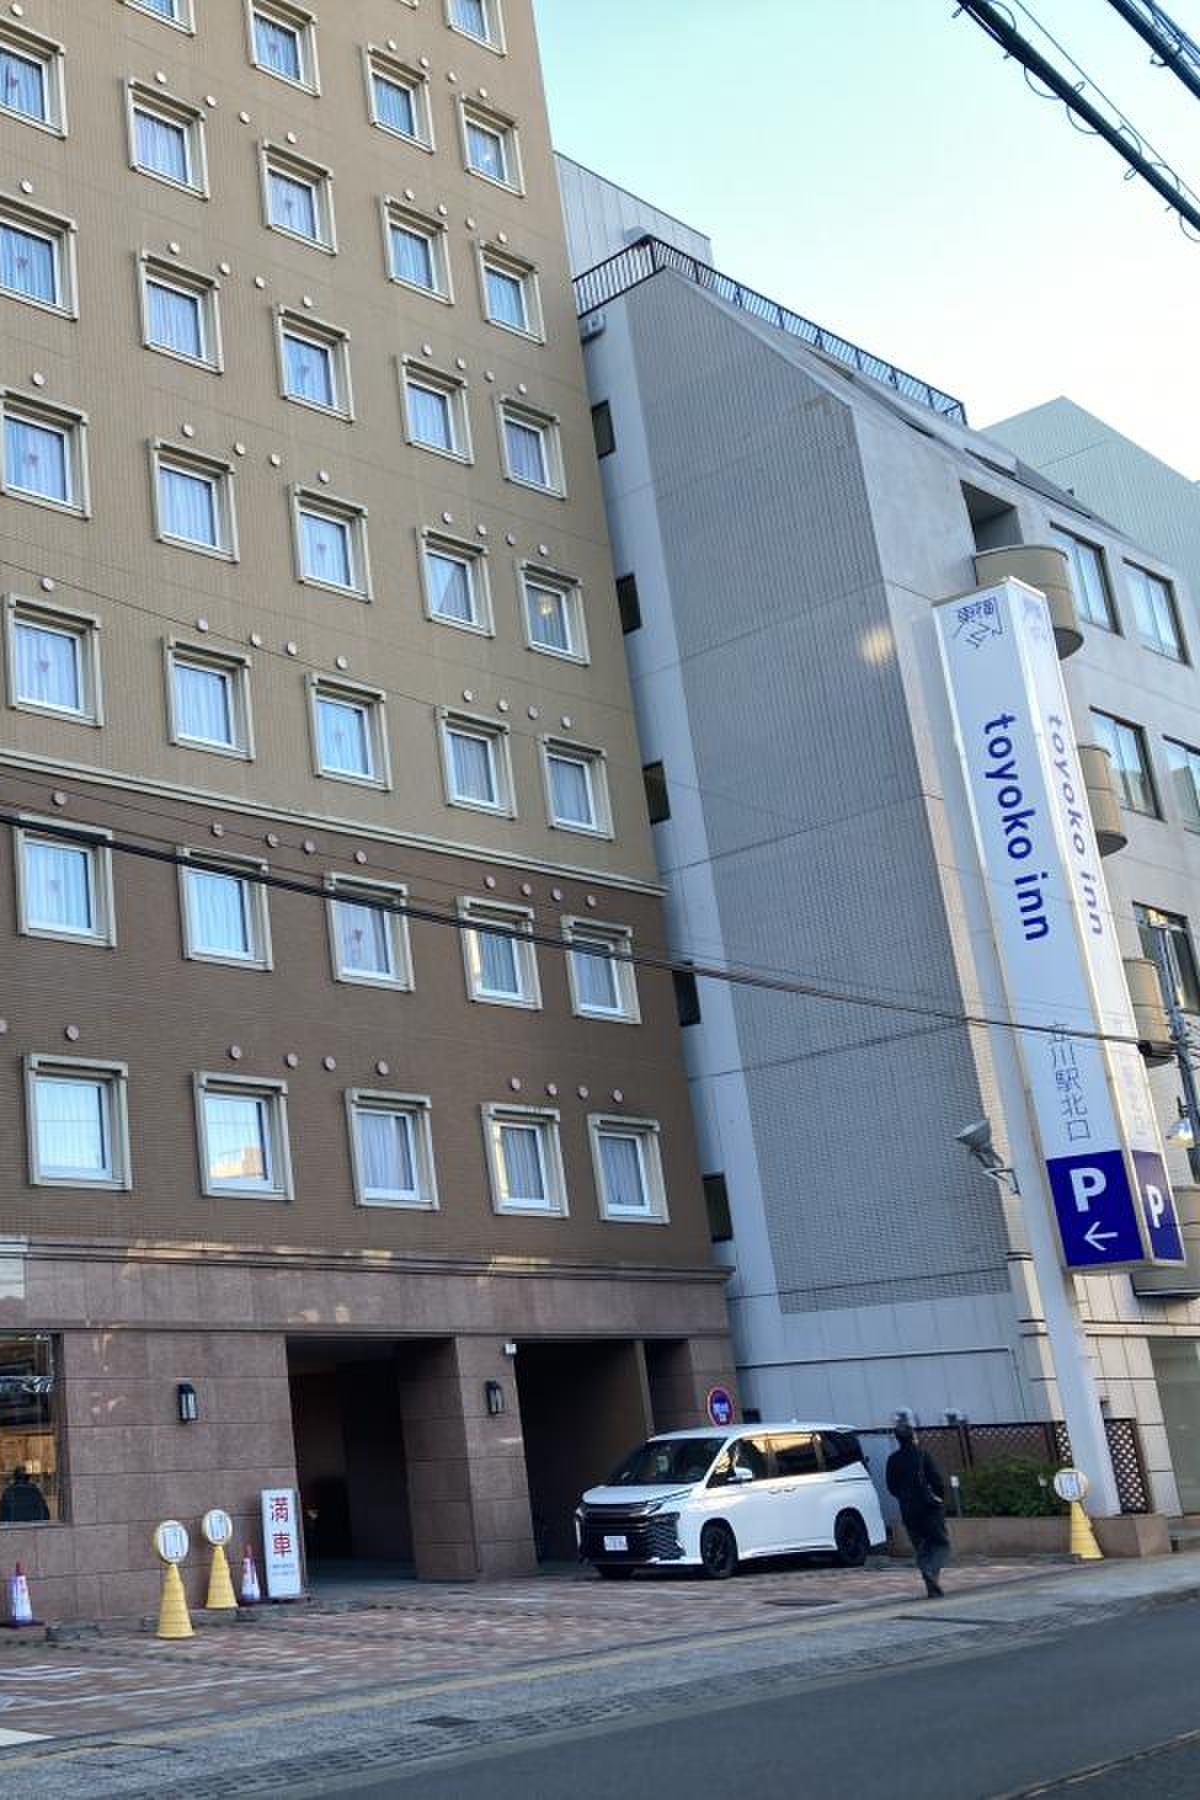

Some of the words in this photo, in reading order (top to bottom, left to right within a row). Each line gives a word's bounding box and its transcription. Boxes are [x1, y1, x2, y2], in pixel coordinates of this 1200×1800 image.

[984, 713, 1035, 859] toyoko
[1014, 871, 1049, 941] inn
[1049, 714, 1085, 855] toyoko
[1080, 871, 1103, 935] inn
[1069, 1167, 1107, 1213] P
[1145, 1183, 1165, 1229] P
[270, 1497, 292, 1557] 満車
